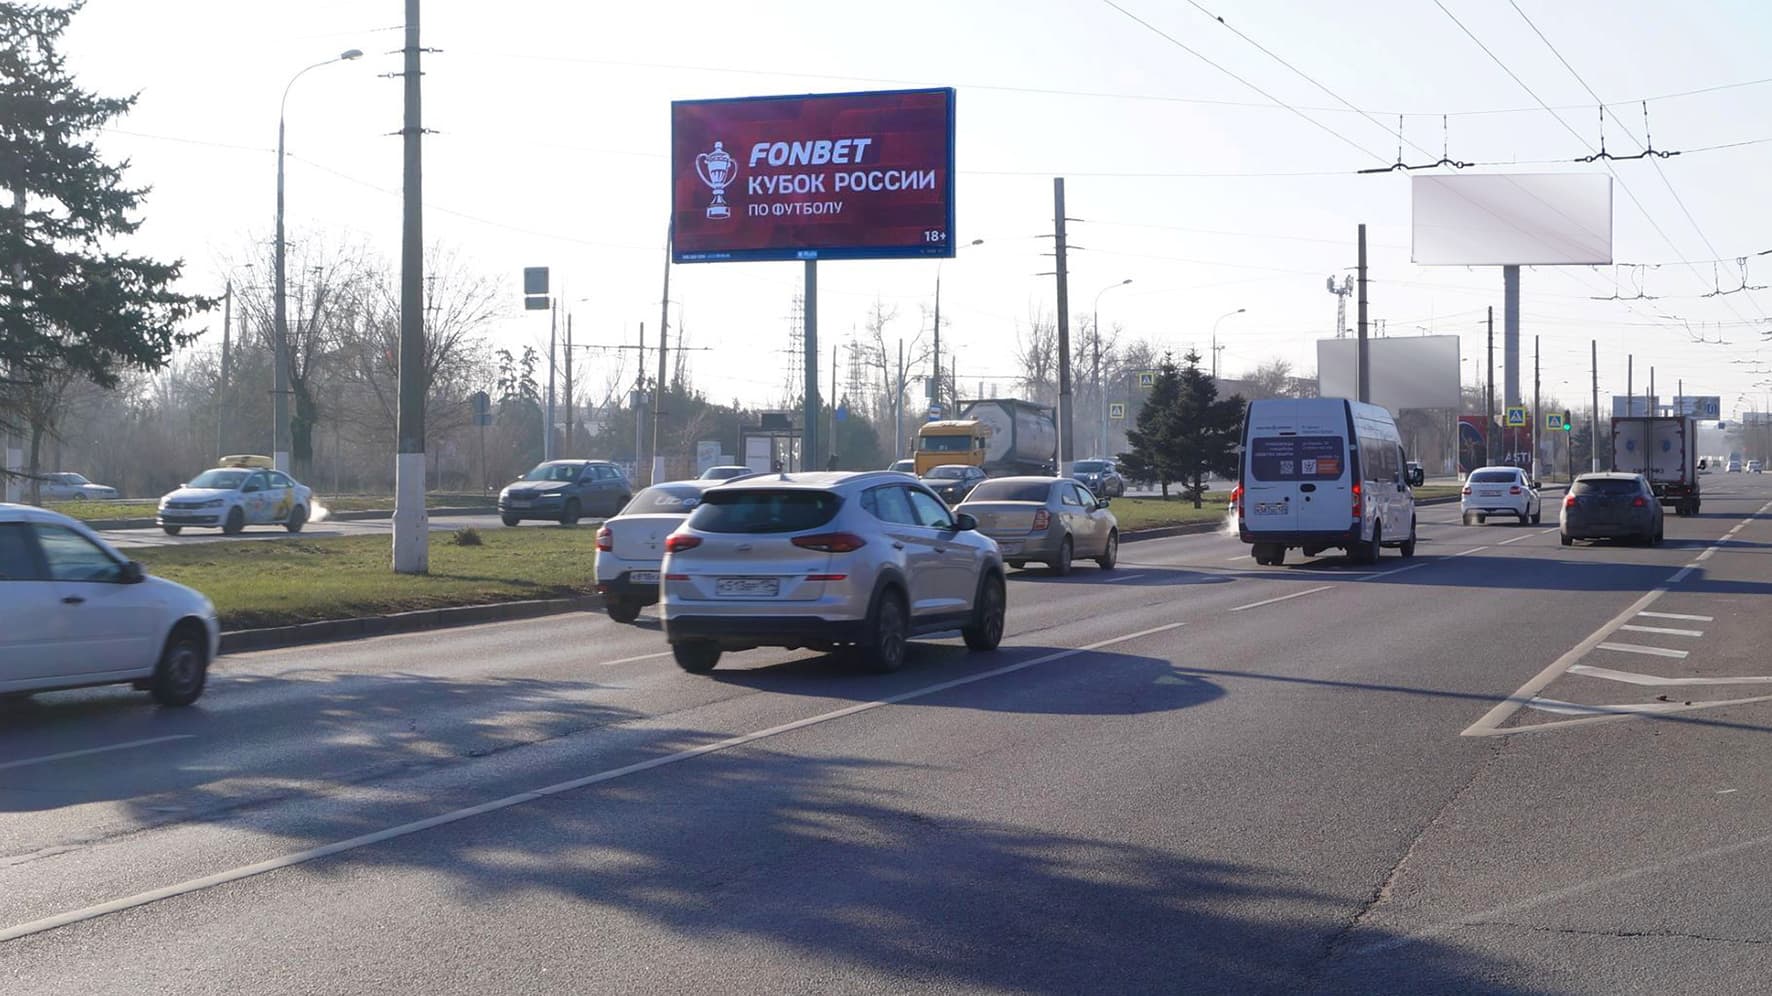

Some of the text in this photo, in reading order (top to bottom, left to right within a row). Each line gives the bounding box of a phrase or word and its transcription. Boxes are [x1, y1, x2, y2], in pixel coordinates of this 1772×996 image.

[748, 138, 872, 167] FONBET
[748, 169, 936, 195] КУБОК РОССИИ
[748, 202, 843, 216] ПО ФУТБОЛУ
[924, 230, 946, 242] 18+
